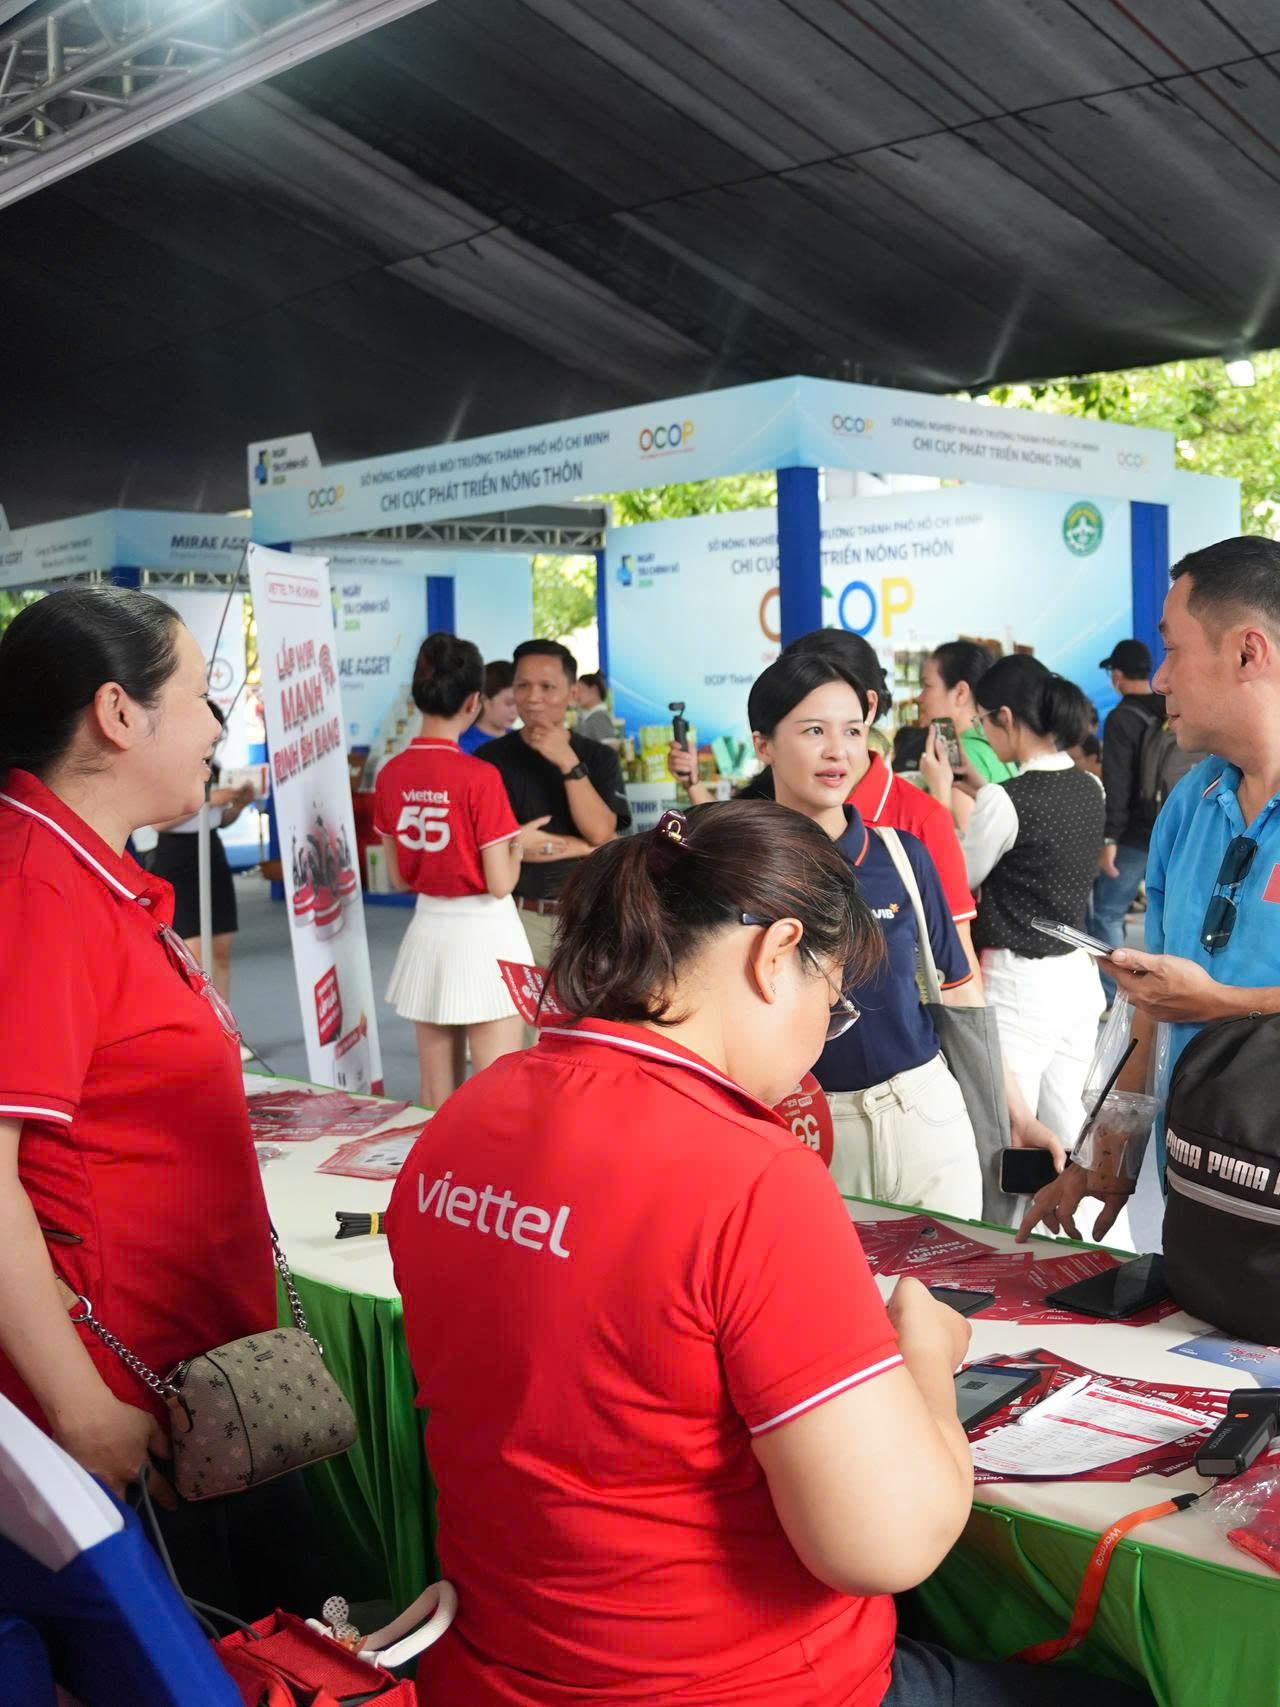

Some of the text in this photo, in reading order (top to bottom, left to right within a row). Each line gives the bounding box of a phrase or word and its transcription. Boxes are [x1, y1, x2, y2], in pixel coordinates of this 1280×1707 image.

[639, 419, 694, 451] OCOP
[832, 414, 875, 433] OCOP
[372, 469, 395, 484] NÔNG
[494, 443, 526, 462] THÀNH
[528, 439, 547, 457] PHỐ
[582, 430, 610, 447] MINH
[913, 437, 932, 451] CHI
[935, 439, 956, 455] CỤC
[959, 440, 987, 457] PHÁT
[1021, 450, 1050, 466] NÔNG
[1054, 453, 1081, 469] THÔN
[308, 484, 344, 509] OCOP
[381, 460, 583, 513] CHI CỤC PHÁT TRIỂN NÔNG THÔN
[858, 523, 891, 537] THÀNH
[893, 519, 915, 535] PHỐ
[954, 512, 983, 527] MINH
[171, 534, 217, 549] MIRAE
[865, 543, 908, 562] NÔNG
[911, 539, 954, 559] THÔN
[731, 558, 752, 575] CHI
[402, 789, 450, 803] viettel
[872, 907, 895, 921] VIB
[1166, 1128, 1202, 1170] PUMA
[1207, 1150, 1270, 1192] PUMA
[418, 1170, 571, 1259] viettel
